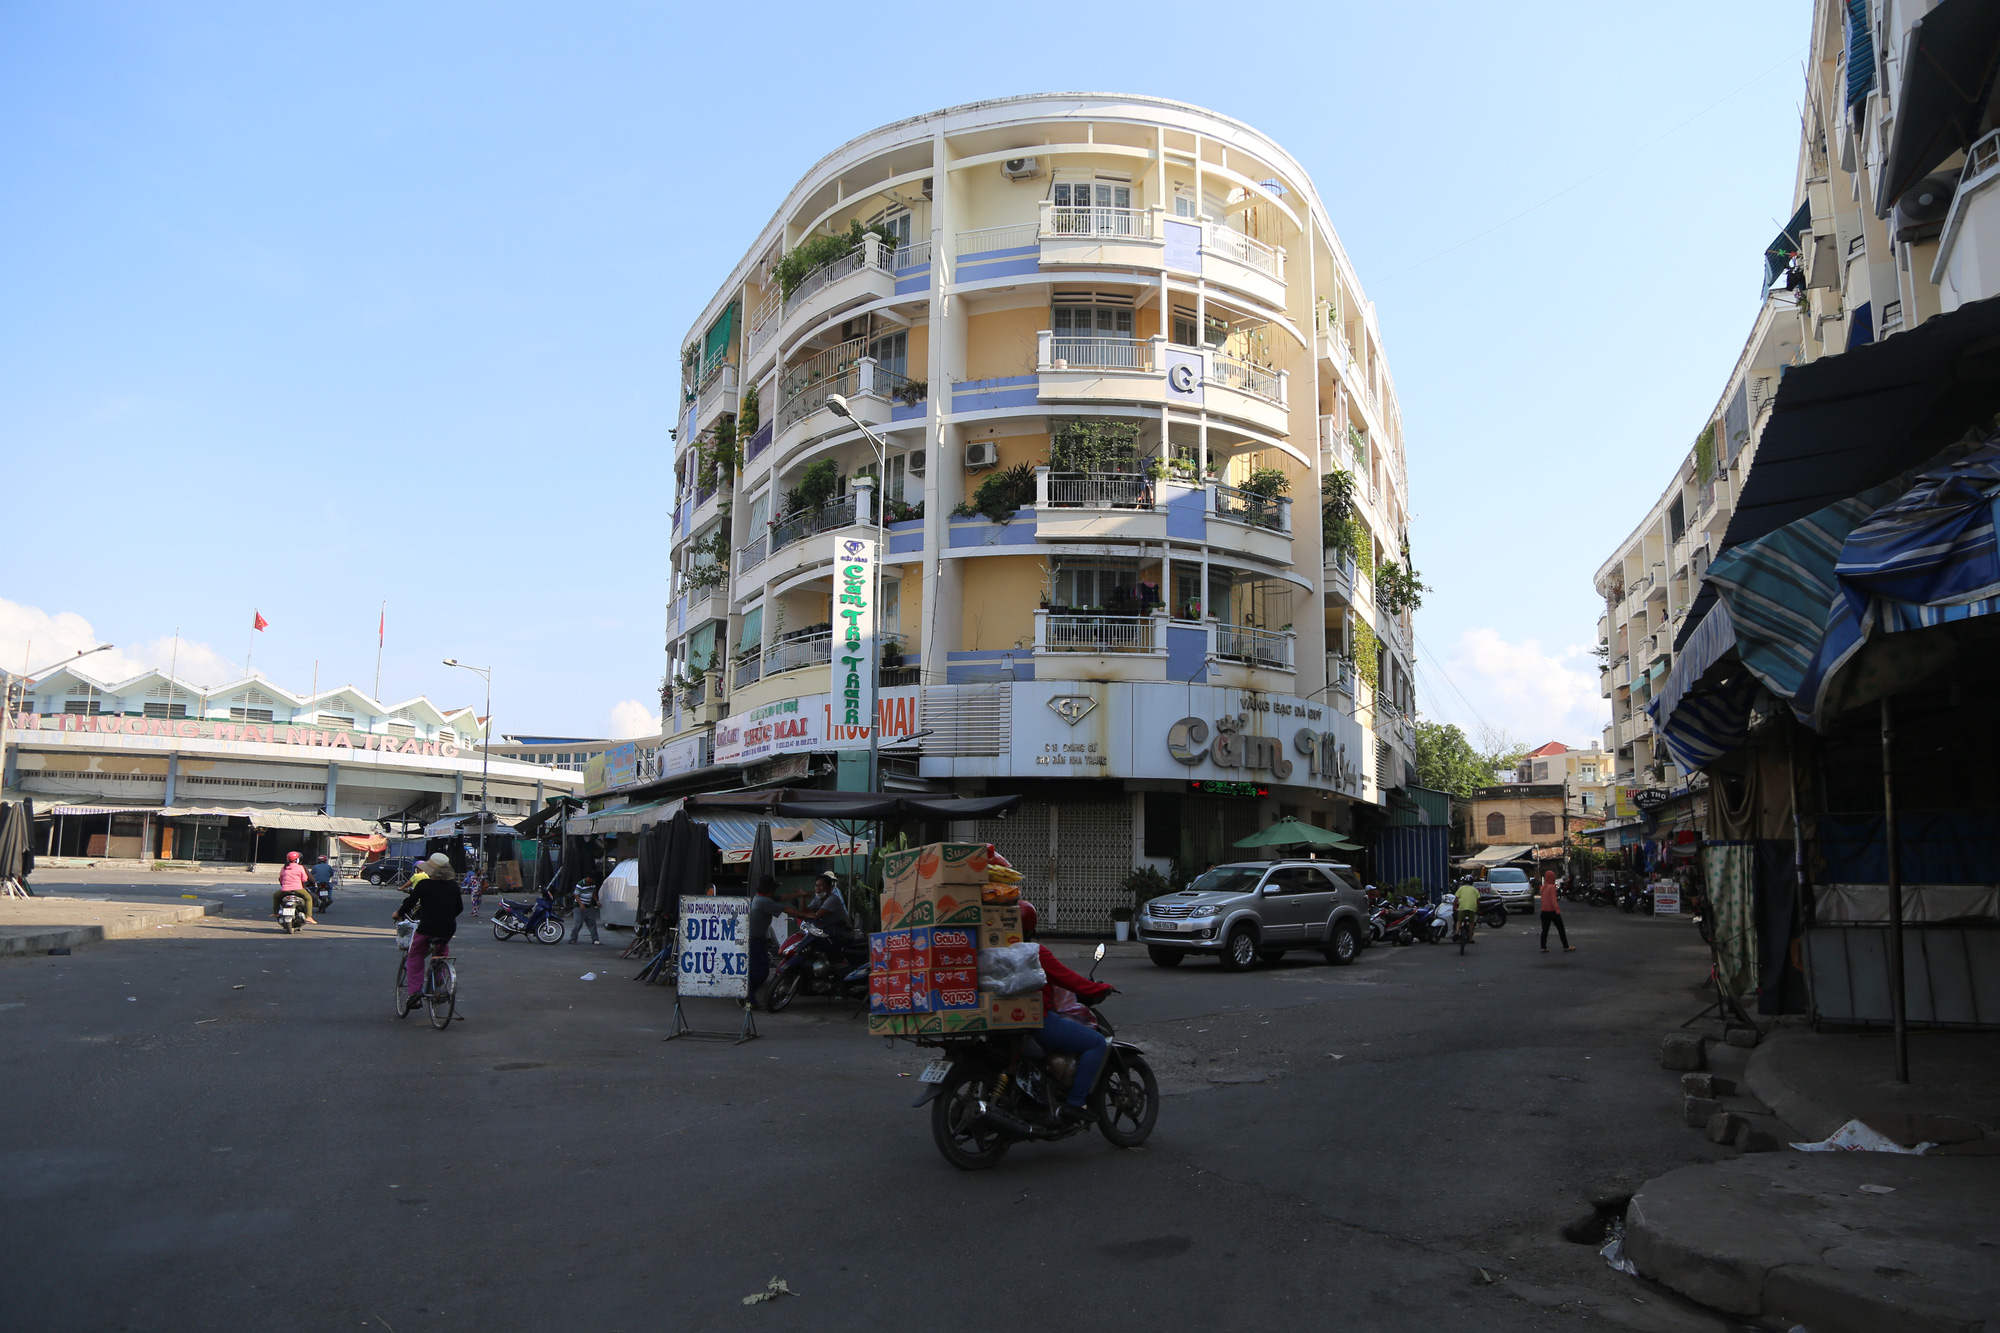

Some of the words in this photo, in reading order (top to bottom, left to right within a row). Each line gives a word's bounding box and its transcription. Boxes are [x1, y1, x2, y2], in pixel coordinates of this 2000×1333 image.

[841, 656, 865, 725] Thanh
[877, 697, 915, 737] MAI
[1240, 696, 1270, 711] VÀNG
[1274, 702, 1292, 716] BẠC
[287, 728, 353, 749] NHA
[360, 733, 459, 758] TRANG
[773, 717, 808, 740] MAI
[681, 946, 717, 974] GIỮ
[721, 952, 748, 975] XE
